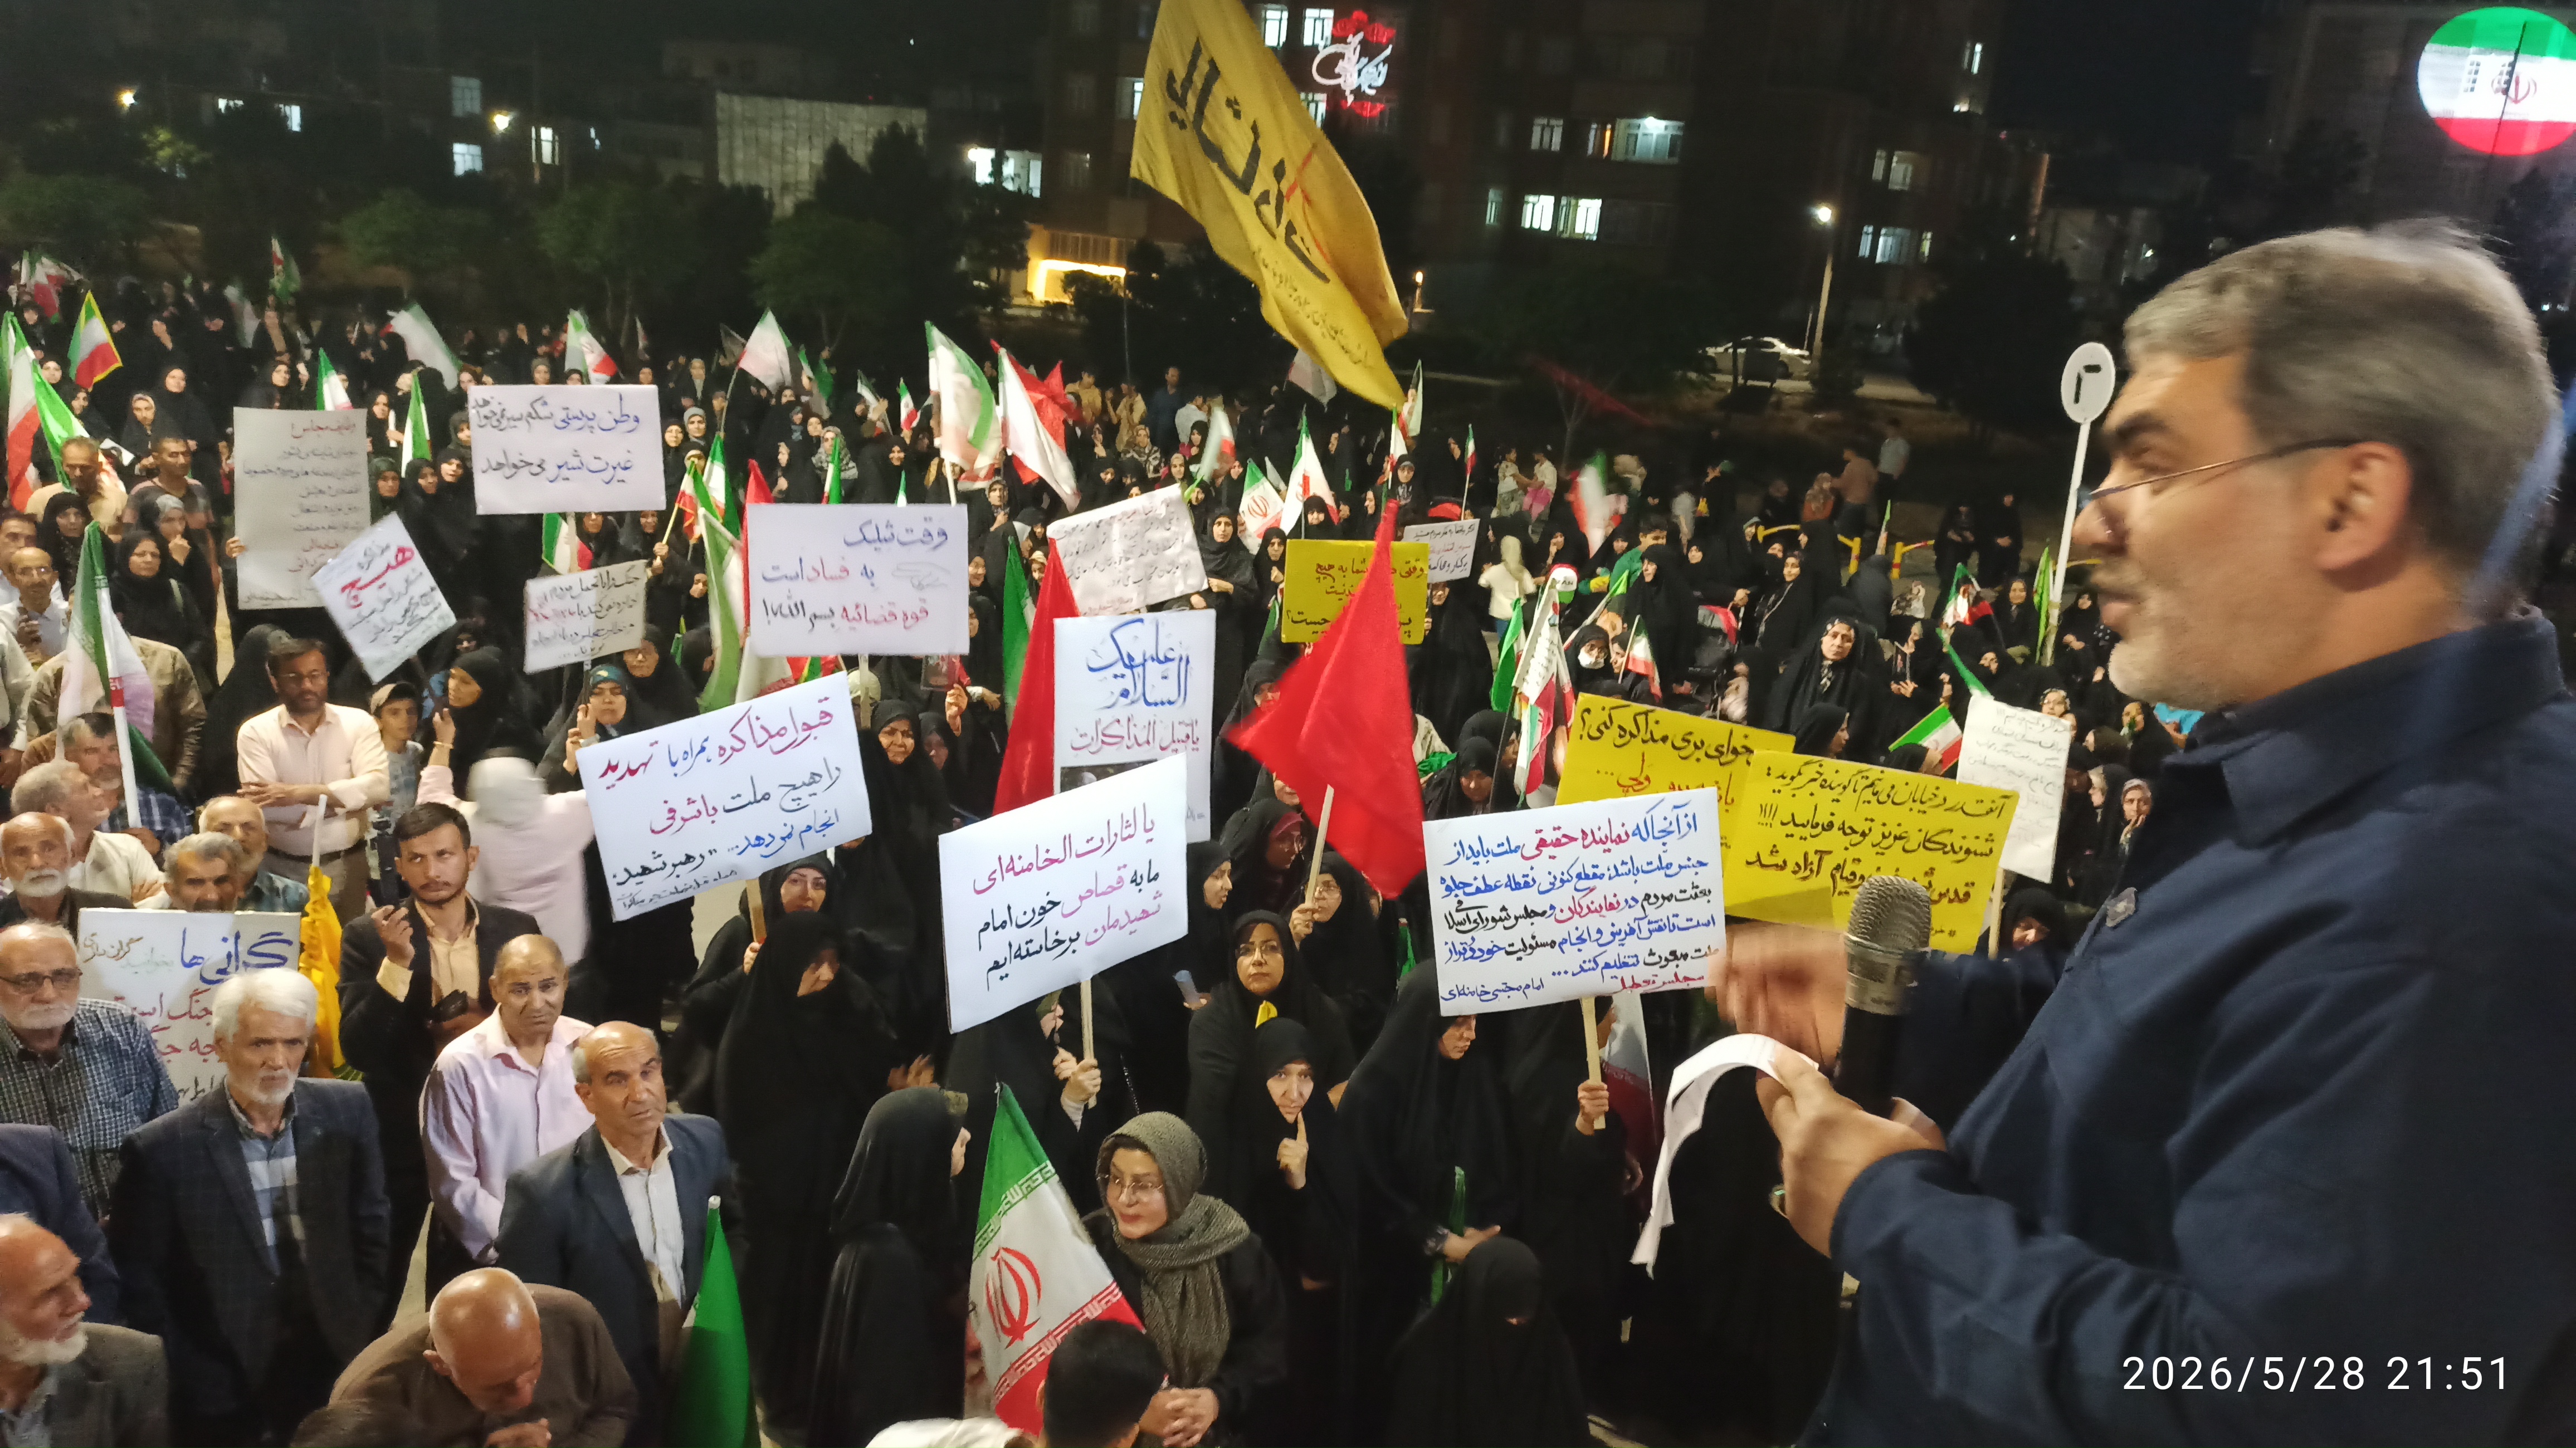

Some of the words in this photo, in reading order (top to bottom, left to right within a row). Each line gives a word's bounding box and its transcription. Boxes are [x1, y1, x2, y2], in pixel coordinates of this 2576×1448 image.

[526, 395, 554, 432] شکم
[554, 407, 597, 433] پرستی
[598, 392, 640, 433] وطن
[547, 449, 584, 483] شیر
[586, 449, 633, 485] غیرت
[843, 519, 895, 551] شلیک
[896, 516, 948, 552] وقت
[340, 546, 414, 609] هیچ
[762, 556, 803, 583] است
[806, 556, 850, 583] فساد
[860, 563, 875, 587] به
[1338, 565, 1348, 578] به
[1399, 558, 1424, 579] وقتی
[808, 606, 835, 633] بسم
[902, 598, 928, 630] قوه
[1086, 618, 1177, 679] علیک
[718, 705, 788, 766] مذاکره
[769, 696, 833, 755] قبول
[1070, 713, 1156, 755] المذاکرات
[1613, 708, 1669, 749] مذاکره
[668, 744, 679, 777] با
[1671, 731, 1705, 762] بری
[598, 740, 659, 790] تهدید
[822, 756, 841, 793] را
[1791, 763, 1824, 796] خبر
[723, 774, 771, 813] ملت
[778, 771, 823, 813] هیچ
[1819, 767, 1872, 803] گوینده
[1891, 782, 1940, 814] خیابان
[798, 808, 839, 850] انجام
[1075, 806, 1137, 858] لثارات
[1143, 802, 1156, 844] یا
[1581, 817, 1630, 853] نماینده
[1677, 811, 1697, 840] از
[1837, 817, 1875, 850] توجه
[1871, 822, 1909, 855] عزیز
[1443, 839, 1465, 866] از
[1466, 835, 1491, 866] باید
[1491, 835, 1521, 857] ملت
[1521, 825, 1579, 861] حقیقی
[1745, 844, 1787, 871] شد
[1902, 828, 1995, 864] شنوندگان
[1147, 859, 1160, 885] ما
[1538, 856, 1579, 895] کنونی
[1641, 849, 1673, 874] ملت
[1664, 856, 1709, 878] جنس
[1791, 850, 1833, 881] آزاد
[1061, 864, 1128, 918] قصاص
[1130, 869, 1143, 894] به
[1440, 875, 1474, 899] جلوه
[1463, 874, 1504, 897] عطف
[1504, 865, 1536, 891] نقطه
[1574, 863, 1606, 892] مقطع
[1675, 881, 1712, 903] بعثت
[1015, 892, 1062, 930] خون
[1455, 904, 1512, 934] شورای
[1503, 904, 1548, 930] مجلس
[1545, 903, 1557, 919] و
[1616, 896, 1640, 913] در
[1641, 892, 1674, 918] مردم
[978, 904, 1013, 951] امام
[1637, 918, 1666, 941] نقش
[1666, 913, 1679, 933] تا
[1676, 914, 1716, 931] است
[1477, 940, 1506, 962] خود
[1504, 931, 1557, 961] مسئولیت
[1558, 925, 1592, 954] انجام
[1572, 950, 1607, 976] کنند
[1643, 948, 1689, 968] مبعوث
[1480, 982, 1522, 1002] مجتبی
[1522, 977, 1544, 1000] امام
